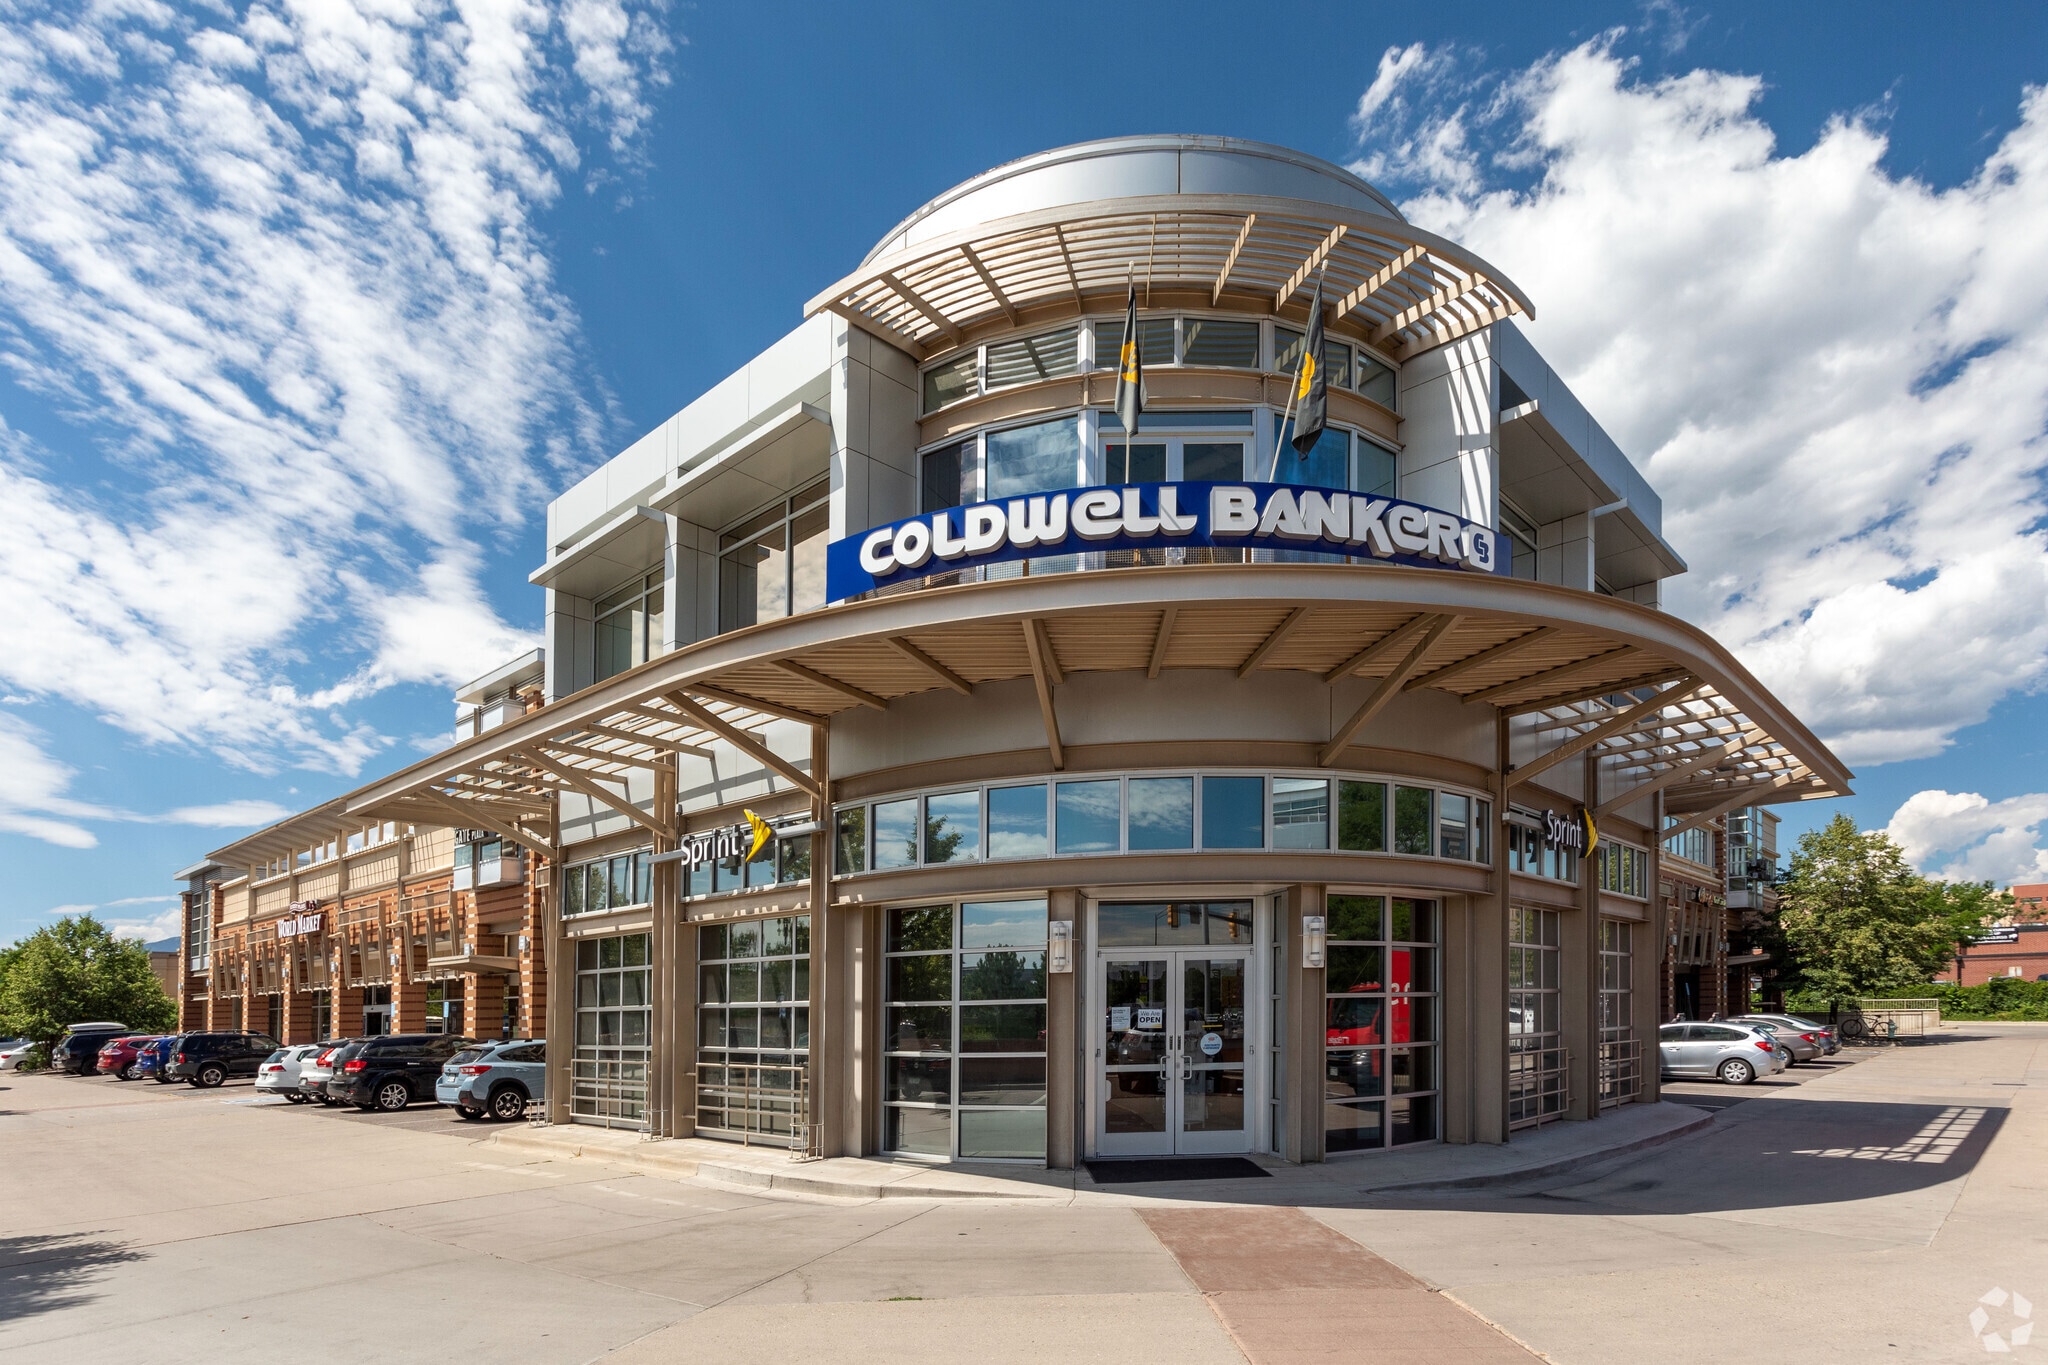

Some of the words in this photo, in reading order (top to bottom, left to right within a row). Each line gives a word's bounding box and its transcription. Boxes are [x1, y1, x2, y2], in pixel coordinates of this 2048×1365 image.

[860, 486, 1198, 575] COLDWELL
[1210, 485, 1462, 564] BANKER
[681, 825, 739, 872] Sprint
[1547, 809, 1582, 850] Sprint
[277, 919, 297, 938] WORLD
[297, 913, 321, 934] MARKET
